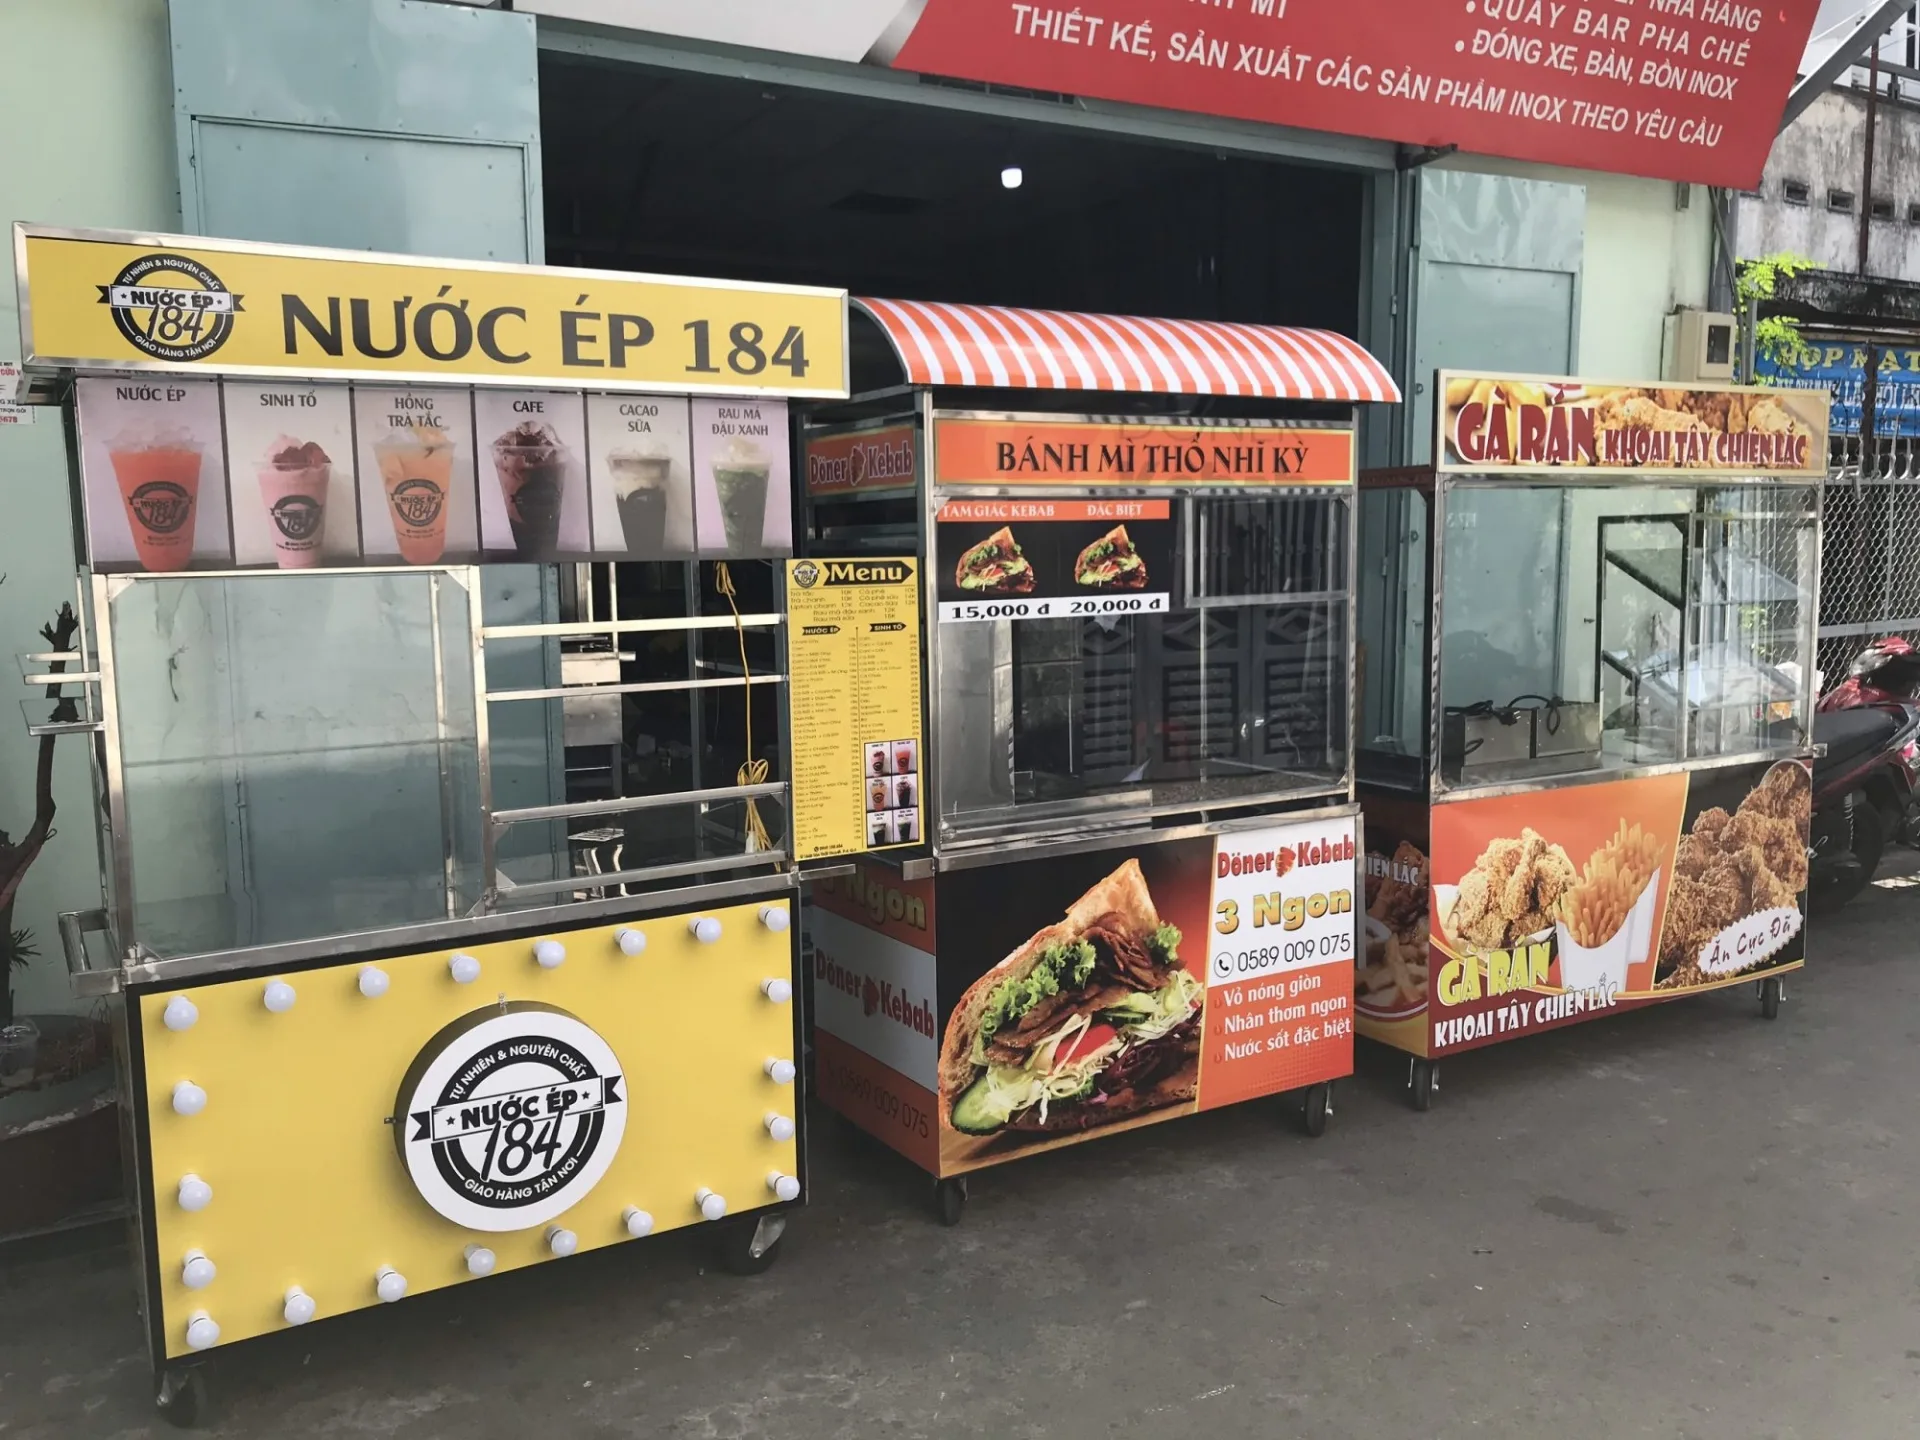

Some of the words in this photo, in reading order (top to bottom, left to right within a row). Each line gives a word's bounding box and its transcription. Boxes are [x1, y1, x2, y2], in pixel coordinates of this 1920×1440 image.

[1573, 8, 1630, 43] BAR
[1639, 21, 1691, 55] PHA
[1700, 36, 1751, 67] CHẾ
[1011, 4, 1103, 46] THIẾT
[1109, 20, 1156, 62] KẾ,
[1167, 29, 1230, 69] SẢN
[1234, 44, 1311, 82] XUẤT
[1316, 56, 1372, 92] CÁC
[1377, 65, 1432, 102] SẢN
[1435, 79, 1506, 113] PHẨM
[1508, 91, 1568, 125] INOX
[1572, 101, 1629, 134] THEO
[1634, 109, 1676, 140] YÊU
[1678, 116, 1723, 148] CẦU
[1472, 28, 1542, 64] ĐÓNG
[1544, 42, 1579, 75] XE,
[1584, 47, 1634, 85] BÀN,
[1639, 56, 1688, 91] BỒN
[1687, 70, 1738, 101] INOX
[130, 260, 155, 278] NHIÊN
[155, 259, 162, 267] &
[163, 259, 202, 275] NGUYÊN
[130, 290, 187, 307] NƯỚC
[190, 292, 214, 309] ÉP
[146, 304, 205, 345] 184
[282, 285, 532, 364] NƯỚC
[560, 294, 655, 368] ÉP
[683, 319, 810, 378] 184
[135, 334, 157, 351] GIAO
[157, 346, 184, 357] HÀNG
[185, 346, 202, 358] TẬN
[201, 338, 217, 351] NƠI
[116, 384, 162, 401] NƯỚC
[166, 384, 186, 401] ÉP
[260, 393, 295, 408] SINH
[298, 390, 317, 408] TỐ
[394, 394, 434, 410] HỒNG
[513, 401, 545, 413] CAFE
[619, 403, 659, 417] CACAO
[387, 413, 414, 428] TRÀ
[627, 418, 652, 433] SỮA
[711, 422, 735, 437] ĐẬU
[737, 423, 769, 436] XANH
[718, 408, 741, 420] RAU
[743, 406, 762, 420] MÁ
[1455, 385, 1511, 462] GÀ
[1518, 388, 1596, 463] RÁN
[1604, 429, 1672, 463] KHOAI
[1674, 423, 1713, 463] TÂY
[1773, 421, 1807, 465] LẮC
[809, 454, 848, 485] Döner
[867, 440, 914, 478] Kebab
[996, 436, 1089, 473] BÁNH
[1099, 437, 1135, 473] MÌ
[1143, 431, 1205, 473] THỔ
[1272, 440, 1309, 474] KỲ
[943, 505, 972, 518] TAM
[974, 502, 1009, 518] GIÁC
[1011, 505, 1055, 518] KEBAB
[1116, 502, 1144, 518] BIỆT
[830, 563, 902, 582] Menu
[951, 603, 1029, 620] 15,000
[1037, 603, 1050, 616] đ
[1070, 599, 1142, 615] 20,000
[1148, 598, 1161, 610] đ
[1217, 850, 1275, 879] Döner
[1297, 834, 1355, 868] Kebab
[844, 866, 928, 932] Ngon
[1215, 898, 1240, 934] 3
[1253, 888, 1352, 932] Ngon
[1237, 946, 1280, 973] 0589
[1284, 939, 1315, 963] 009
[1320, 933, 1351, 956] 075
[1709, 939, 1730, 969] Ăn
[1737, 932, 1765, 955] Cực
[1770, 915, 1792, 940] Đã
[1223, 985, 1243, 1007] Vỏ
[1248, 982, 1285, 1004] nóng
[1290, 974, 1321, 1000] giòn
[1437, 944, 1482, 1007] GÀ
[1487, 935, 1551, 997] RÁN
[816, 948, 862, 996] Döner
[880, 980, 935, 1040] Kebab
[1434, 1011, 1494, 1048] KHOAI
[1497, 999, 1532, 1033] TÂY
[1535, 984, 1586, 1023] CHIÊN
[1588, 972, 1618, 1012] LẮC
[1224, 1011, 1264, 1035] Nhân
[1268, 1003, 1305, 1025] thơm
[1311, 995, 1347, 1017] ngon
[1225, 1036, 1263, 1062] Nước
[1267, 1028, 1290, 1051] sốt
[1294, 1027, 1320, 1048] đặc
[1324, 1017, 1352, 1041] biệt
[449, 1079, 467, 1101] TỰ
[461, 1055, 496, 1085] NHIÊN
[497, 1050, 507, 1060] &
[509, 1043, 560, 1060] NGUYÊN
[559, 1053, 587, 1079] CHẤT
[460, 1094, 540, 1131] NƯỚC
[546, 1087, 578, 1114] ÉP
[902, 1101, 929, 1140] 075
[480, 1109, 562, 1183] 184
[464, 1178, 494, 1198] GIAO
[496, 1186, 533, 1201] HÀNG
[534, 1175, 557, 1194] TẬN
[558, 1157, 579, 1178] NƠI
